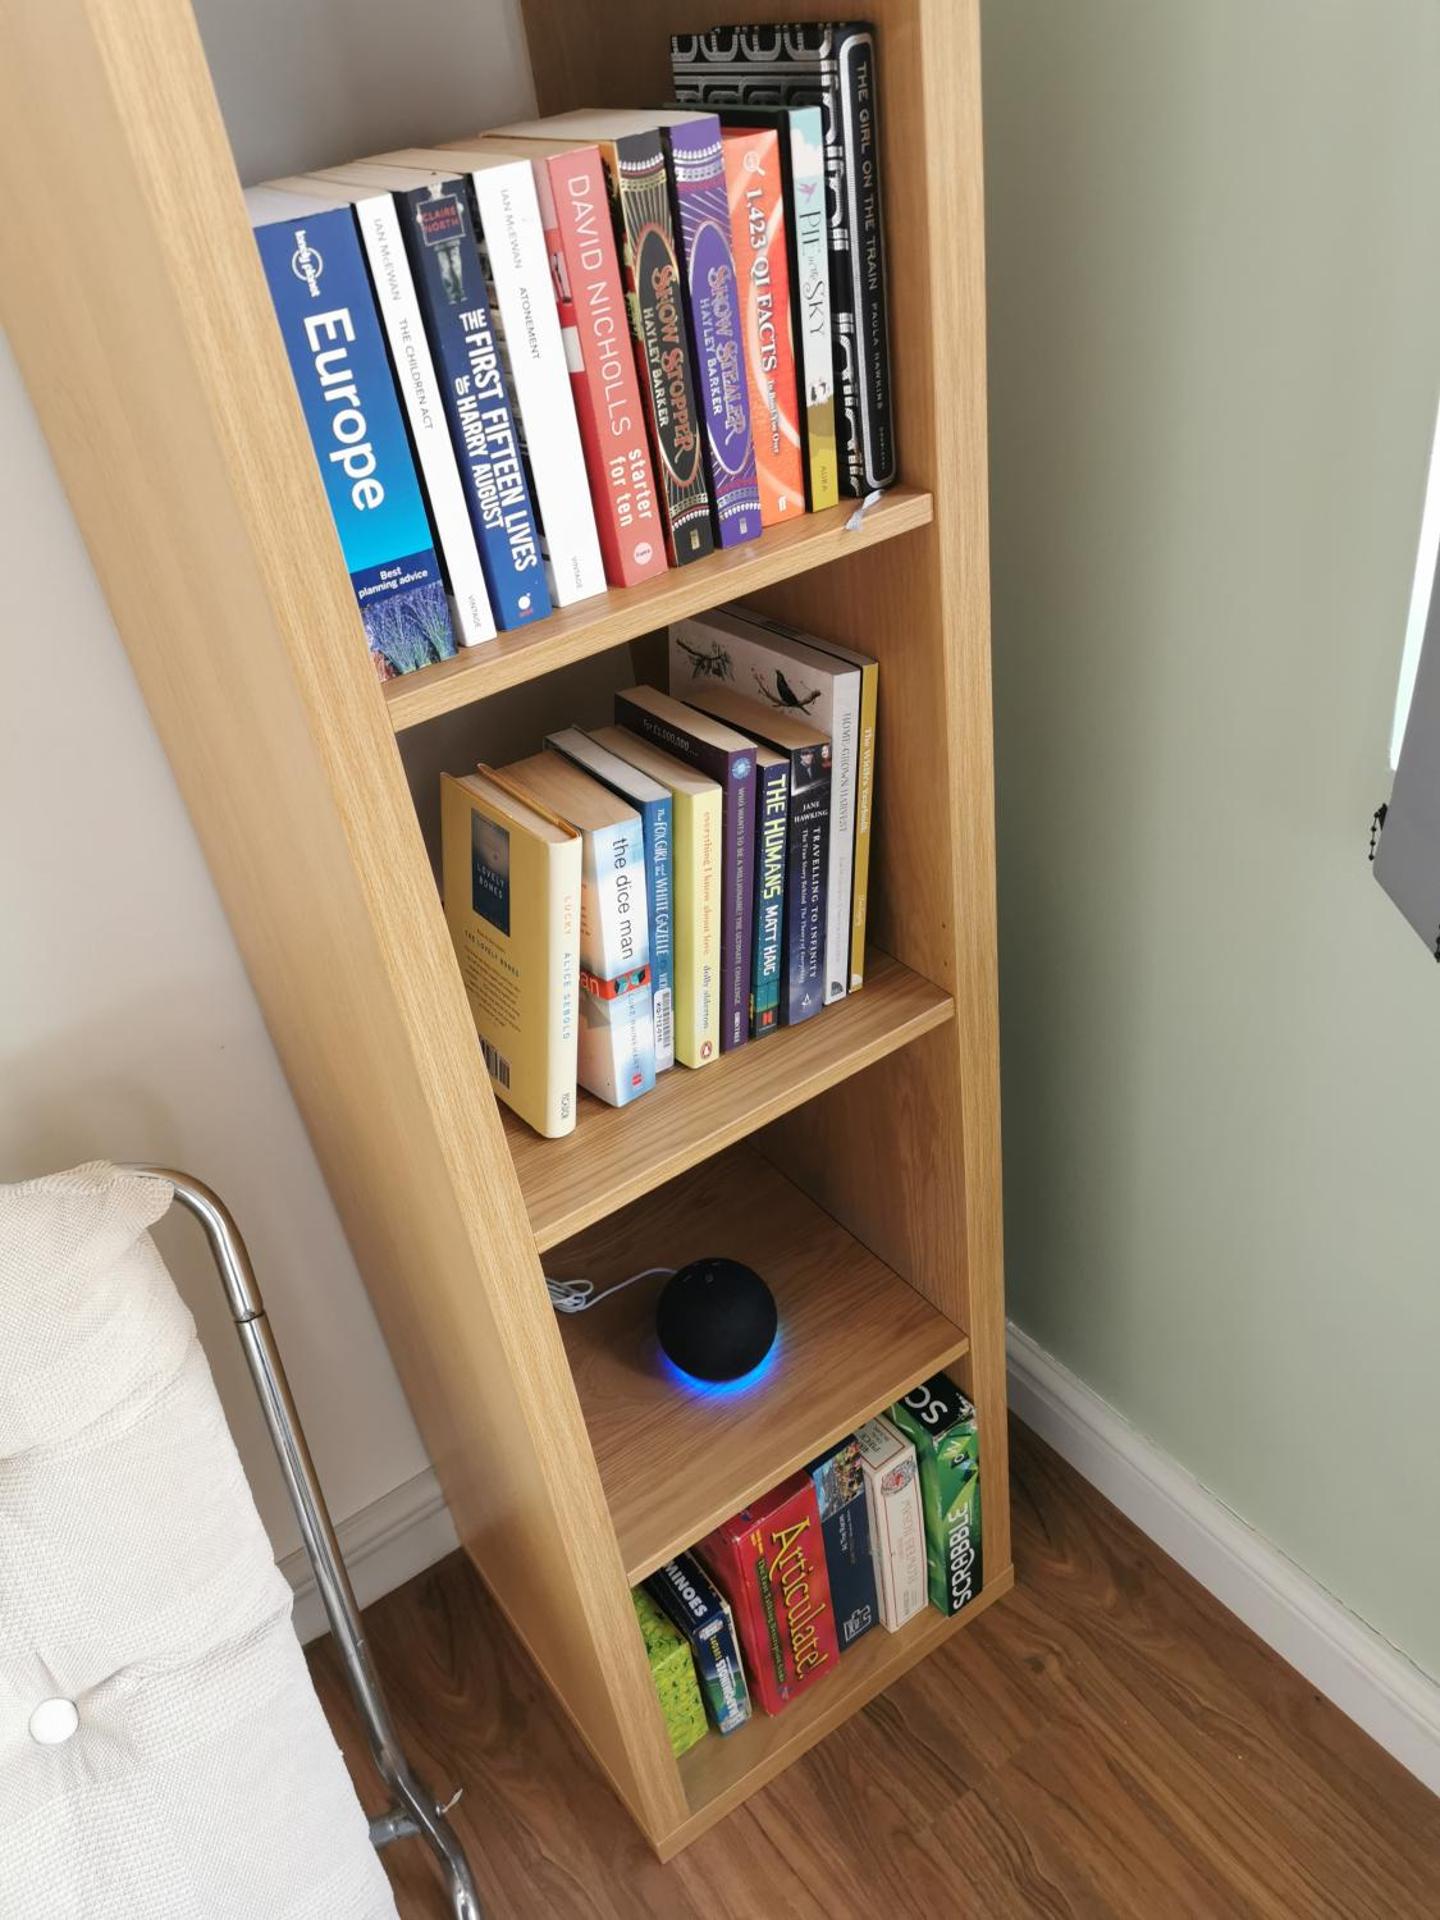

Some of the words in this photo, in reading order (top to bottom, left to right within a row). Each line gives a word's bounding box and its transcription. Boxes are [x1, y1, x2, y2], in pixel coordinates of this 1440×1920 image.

[856, 62, 868, 103] THE
[859, 109, 871, 155] GIRL
[862, 161, 873, 188] ON
[420, 207, 457, 221] CLAIRE
[423, 218, 459, 233] NORTH
[863, 194, 875, 232] THE
[750, 255, 769, 288] QI
[866, 238, 878, 291] TRAIN
[459, 308, 488, 332] THE
[519, 287, 541, 360] ATONEMENT
[567, 174, 603, 271] DAVID
[586, 281, 631, 436] NICHOLLS
[699, 297, 718, 354] HAYLEY
[803, 280, 825, 338] SKY
[398, 317, 413, 344] THE
[643, 306, 662, 365] HAYLEY
[756, 294, 779, 373] FACTS
[405, 345, 427, 405] CHILDREN
[454, 375, 471, 396] OF
[465, 331, 504, 400] FIRST
[706, 357, 723, 416] BARKER
[303, 307, 385, 512] Europe
[419, 405, 434, 430] ACT
[651, 369, 670, 428] BARKER
[456, 396, 488, 459] HARRY
[480, 406, 526, 508] FIFTEEN
[608, 455, 627, 487] for
[471, 464, 505, 530] AUGUST
[628, 448, 653, 519] starter
[616, 492, 634, 528] ten
[504, 510, 538, 572] LIVES
[358, 576, 398, 600] planning
[399, 568, 429, 585] advice
[379, 566, 403, 581] Best
[764, 772, 787, 816] THE
[794, 808, 829, 824] HAWKING
[802, 800, 820, 812] JANE
[612, 837, 627, 870] the
[654, 840, 668, 864] GIRL
[763, 817, 786, 900] HUMANS
[811, 827, 822, 904] TRAVELLING
[615, 873, 631, 915] dice
[654, 876, 669, 911] WHITE
[810, 905, 819, 924] TO
[617, 918, 635, 961] man
[655, 912, 669, 956] GAZELLE
[763, 903, 779, 947] MATT
[763, 948, 778, 978] HAIG
[808, 926, 819, 979] INFINITY
[948, 1500, 976, 1611] SCRABBLE
[664, 1559, 708, 1618] MINOES
[768, 1515, 829, 1680] Articulate!
